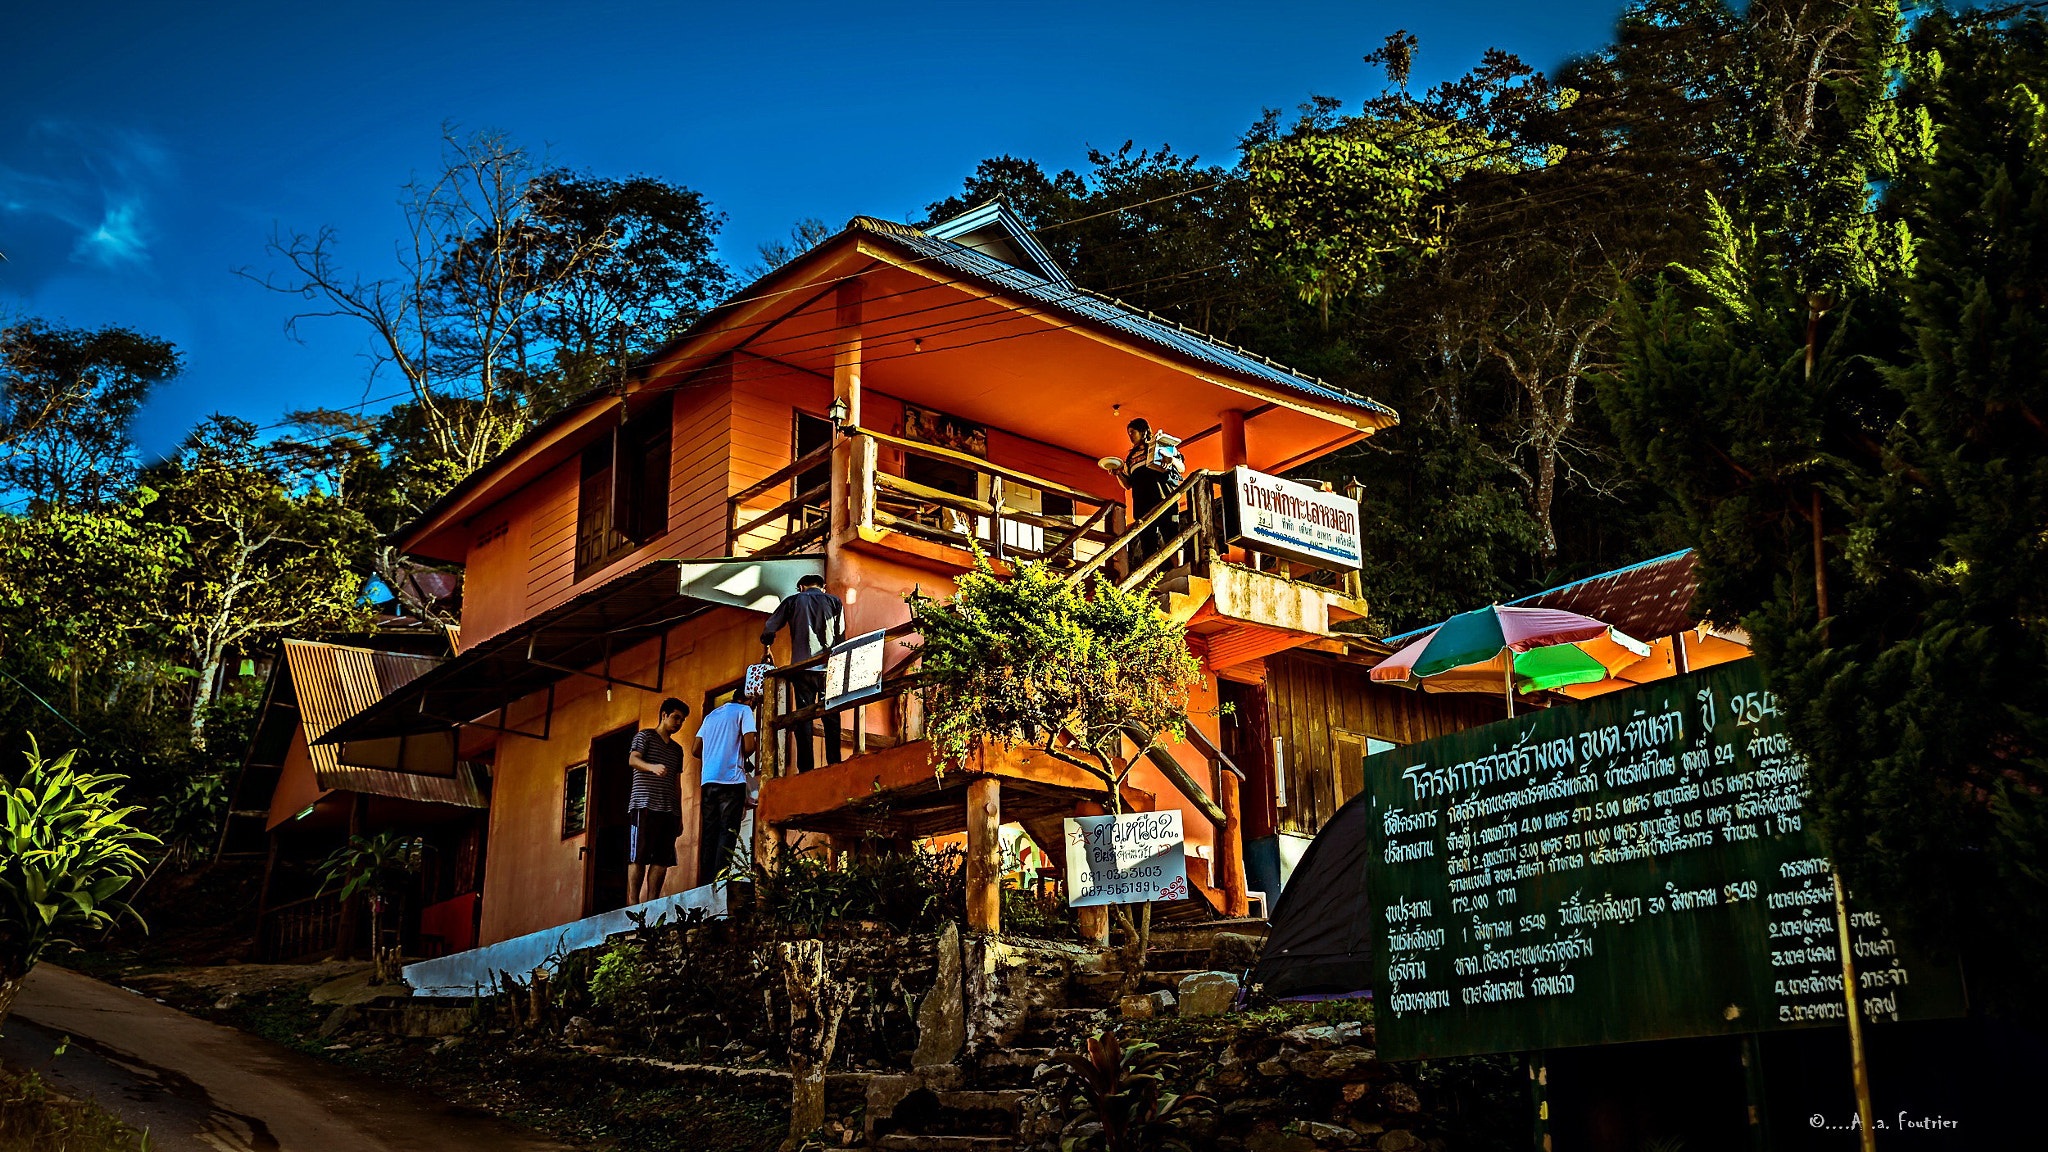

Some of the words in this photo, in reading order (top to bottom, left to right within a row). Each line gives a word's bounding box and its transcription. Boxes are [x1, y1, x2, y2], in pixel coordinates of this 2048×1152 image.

[1243, 476, 1355, 535] บ้านพักทะเลหมอก
[1402, 723, 1575, 801] โครงการก่อสร้างของ
[1578, 699, 1684, 762] อบต.ตับเต่า
[1697, 686, 1716, 733] ปี
[1731, 691, 1787, 727] 254
[1384, 804, 1438, 836] ชื่อโครงการ
[1714, 742, 1735, 766] 24
[1384, 840, 1434, 865] ปริมาณงาน
[1521, 816, 1543, 834] 4.00
[1544, 809, 1570, 830] เมตร
[1571, 805, 1592, 825] ยาว
[1594, 799, 1620, 821] 5.00
[1623, 793, 1651, 814] เมตร
[1702, 776, 1725, 798] 0.15
[1726, 770, 1755, 793] เมตร
[1519, 843, 1539, 858] 3.00
[1540, 836, 1564, 855] เมตร
[1564, 836, 1581, 851] ยาว
[1613, 821, 1638, 843] เมตร
[1706, 803, 1732, 825] เมตร
[1548, 852, 1584, 873] กำหนด
[1722, 822, 1759, 844] จำนวน
[1764, 820, 1771, 836] 1
[1777, 812, 1802, 834] ป้าย
[1385, 895, 1433, 924] งบประมาณ
[1496, 887, 1517, 906] บาท
[1388, 921, 1445, 952] วันเริ่มสัญญา
[1462, 927, 1468, 944] 1
[1473, 914, 1513, 942] สิงหาคม
[1558, 887, 1642, 929] วันสิ้นสุดสัญญา
[1649, 896, 1666, 915] 30
[1665, 881, 1718, 912] สิงหาคม
[1388, 951, 1427, 984] ผู้รับจ้าง
[1390, 983, 1450, 1019] ผู้ควบคุมงาน
